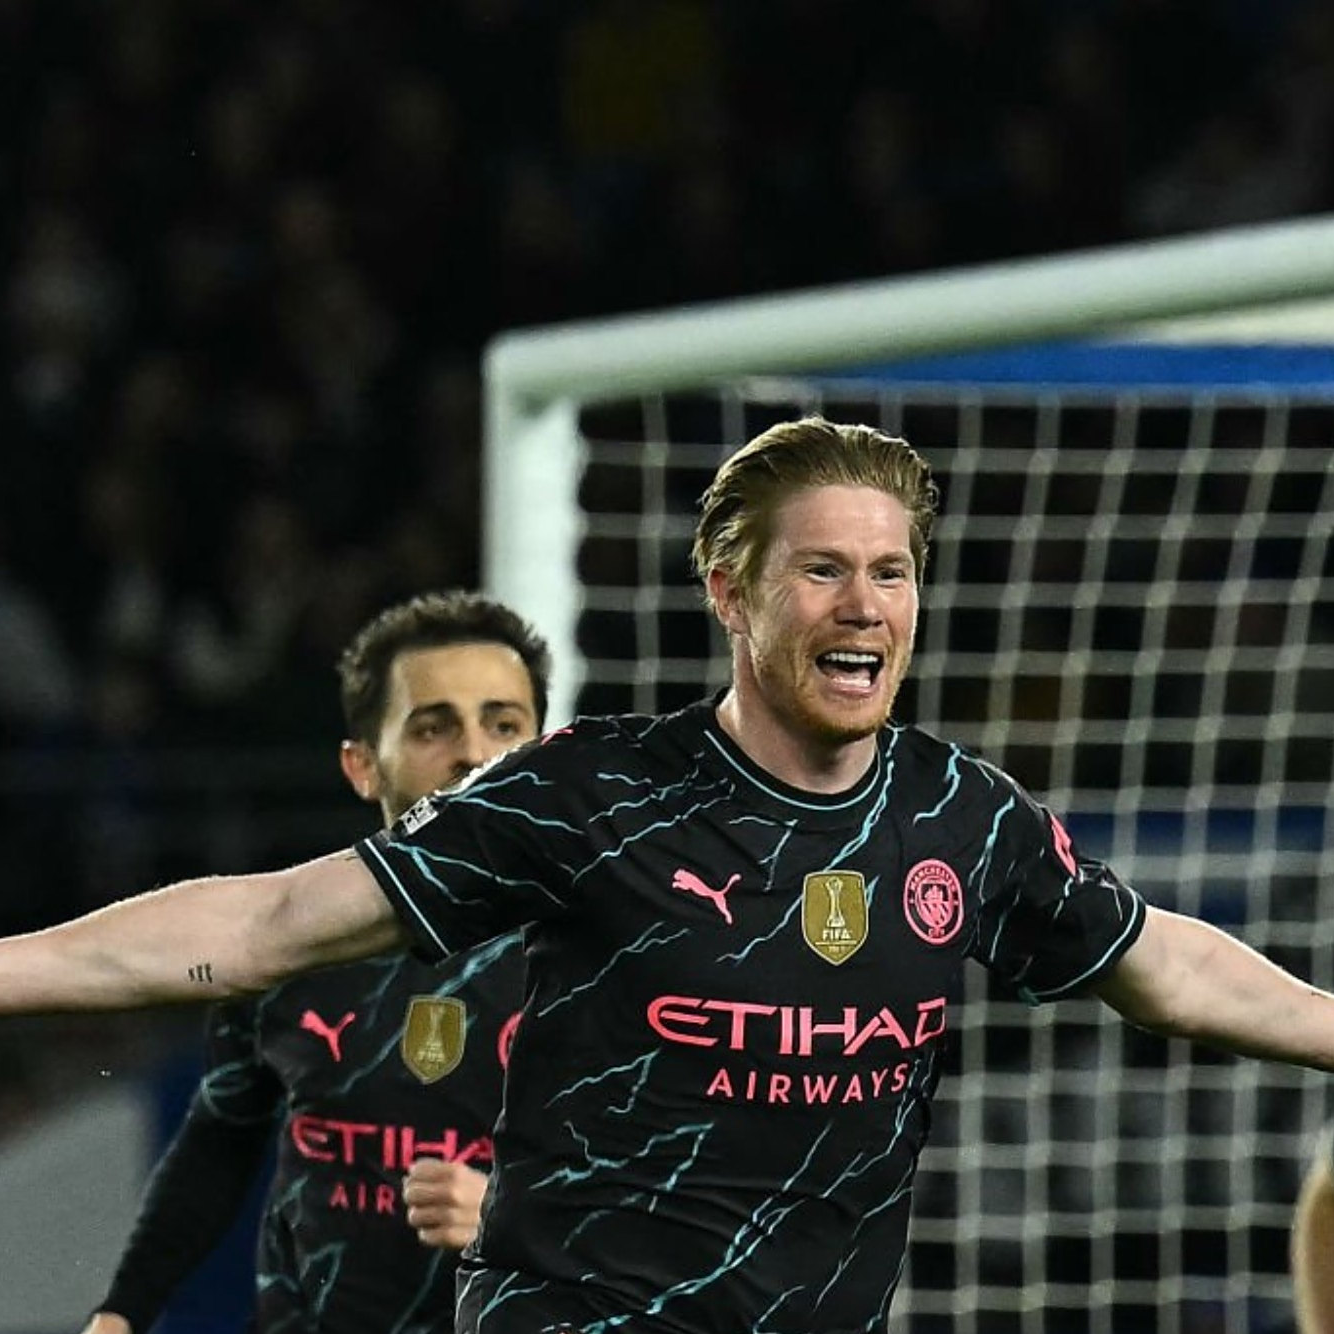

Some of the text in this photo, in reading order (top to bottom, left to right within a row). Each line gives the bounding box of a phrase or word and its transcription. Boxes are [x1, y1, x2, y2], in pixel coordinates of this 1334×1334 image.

[822, 928, 851, 941] FIFA
[647, 995, 948, 1057] ETIHAD
[706, 1062, 910, 1104] AIRWAYS
[292, 1115, 494, 1169] ETIHA
